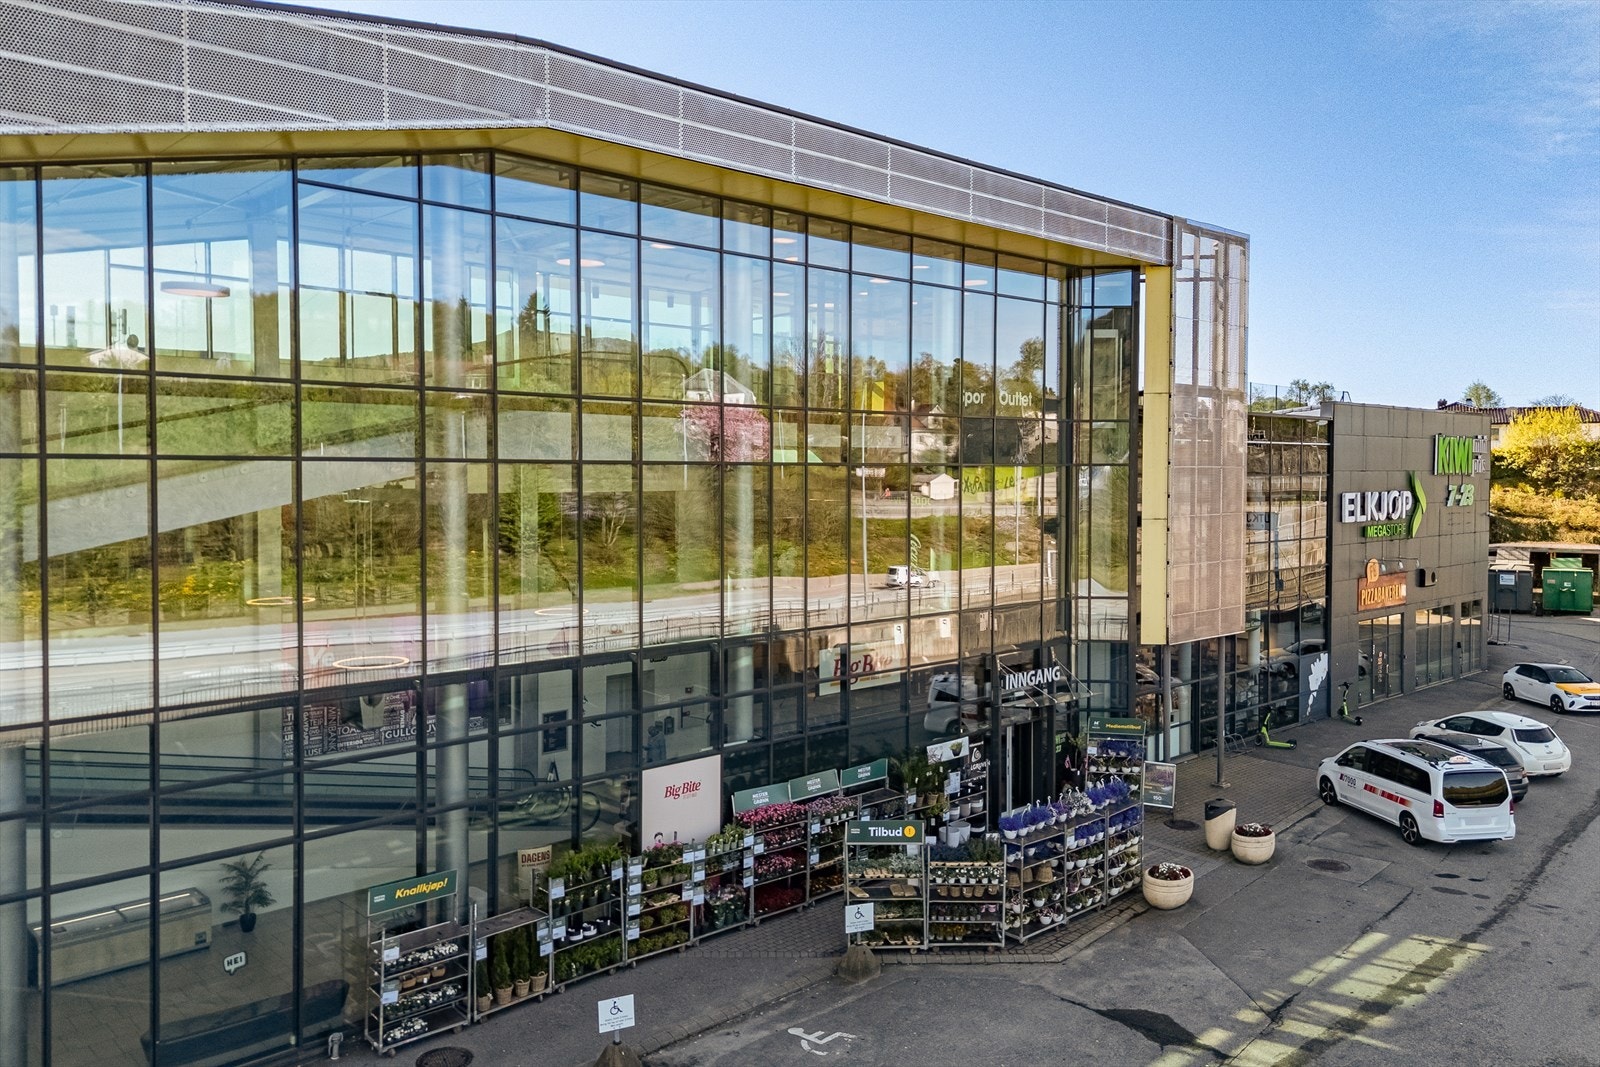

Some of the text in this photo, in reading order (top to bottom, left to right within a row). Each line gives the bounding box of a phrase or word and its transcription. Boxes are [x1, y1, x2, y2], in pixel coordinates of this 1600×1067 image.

[962, 390, 1032, 407] por Outlet
[1434, 434, 1473, 475] KIWI
[1366, 522, 1406, 538] MEGASTORE
[1005, 665, 1061, 691] INNGANG
[664, 784, 681, 799] Big
[681, 780, 702, 795] Bite
[868, 826, 903, 837] Tilbud
[521, 850, 550, 864] DAGENS
[395, 877, 449, 900] Knallkjøp!
[226, 955, 243, 967] HEI
